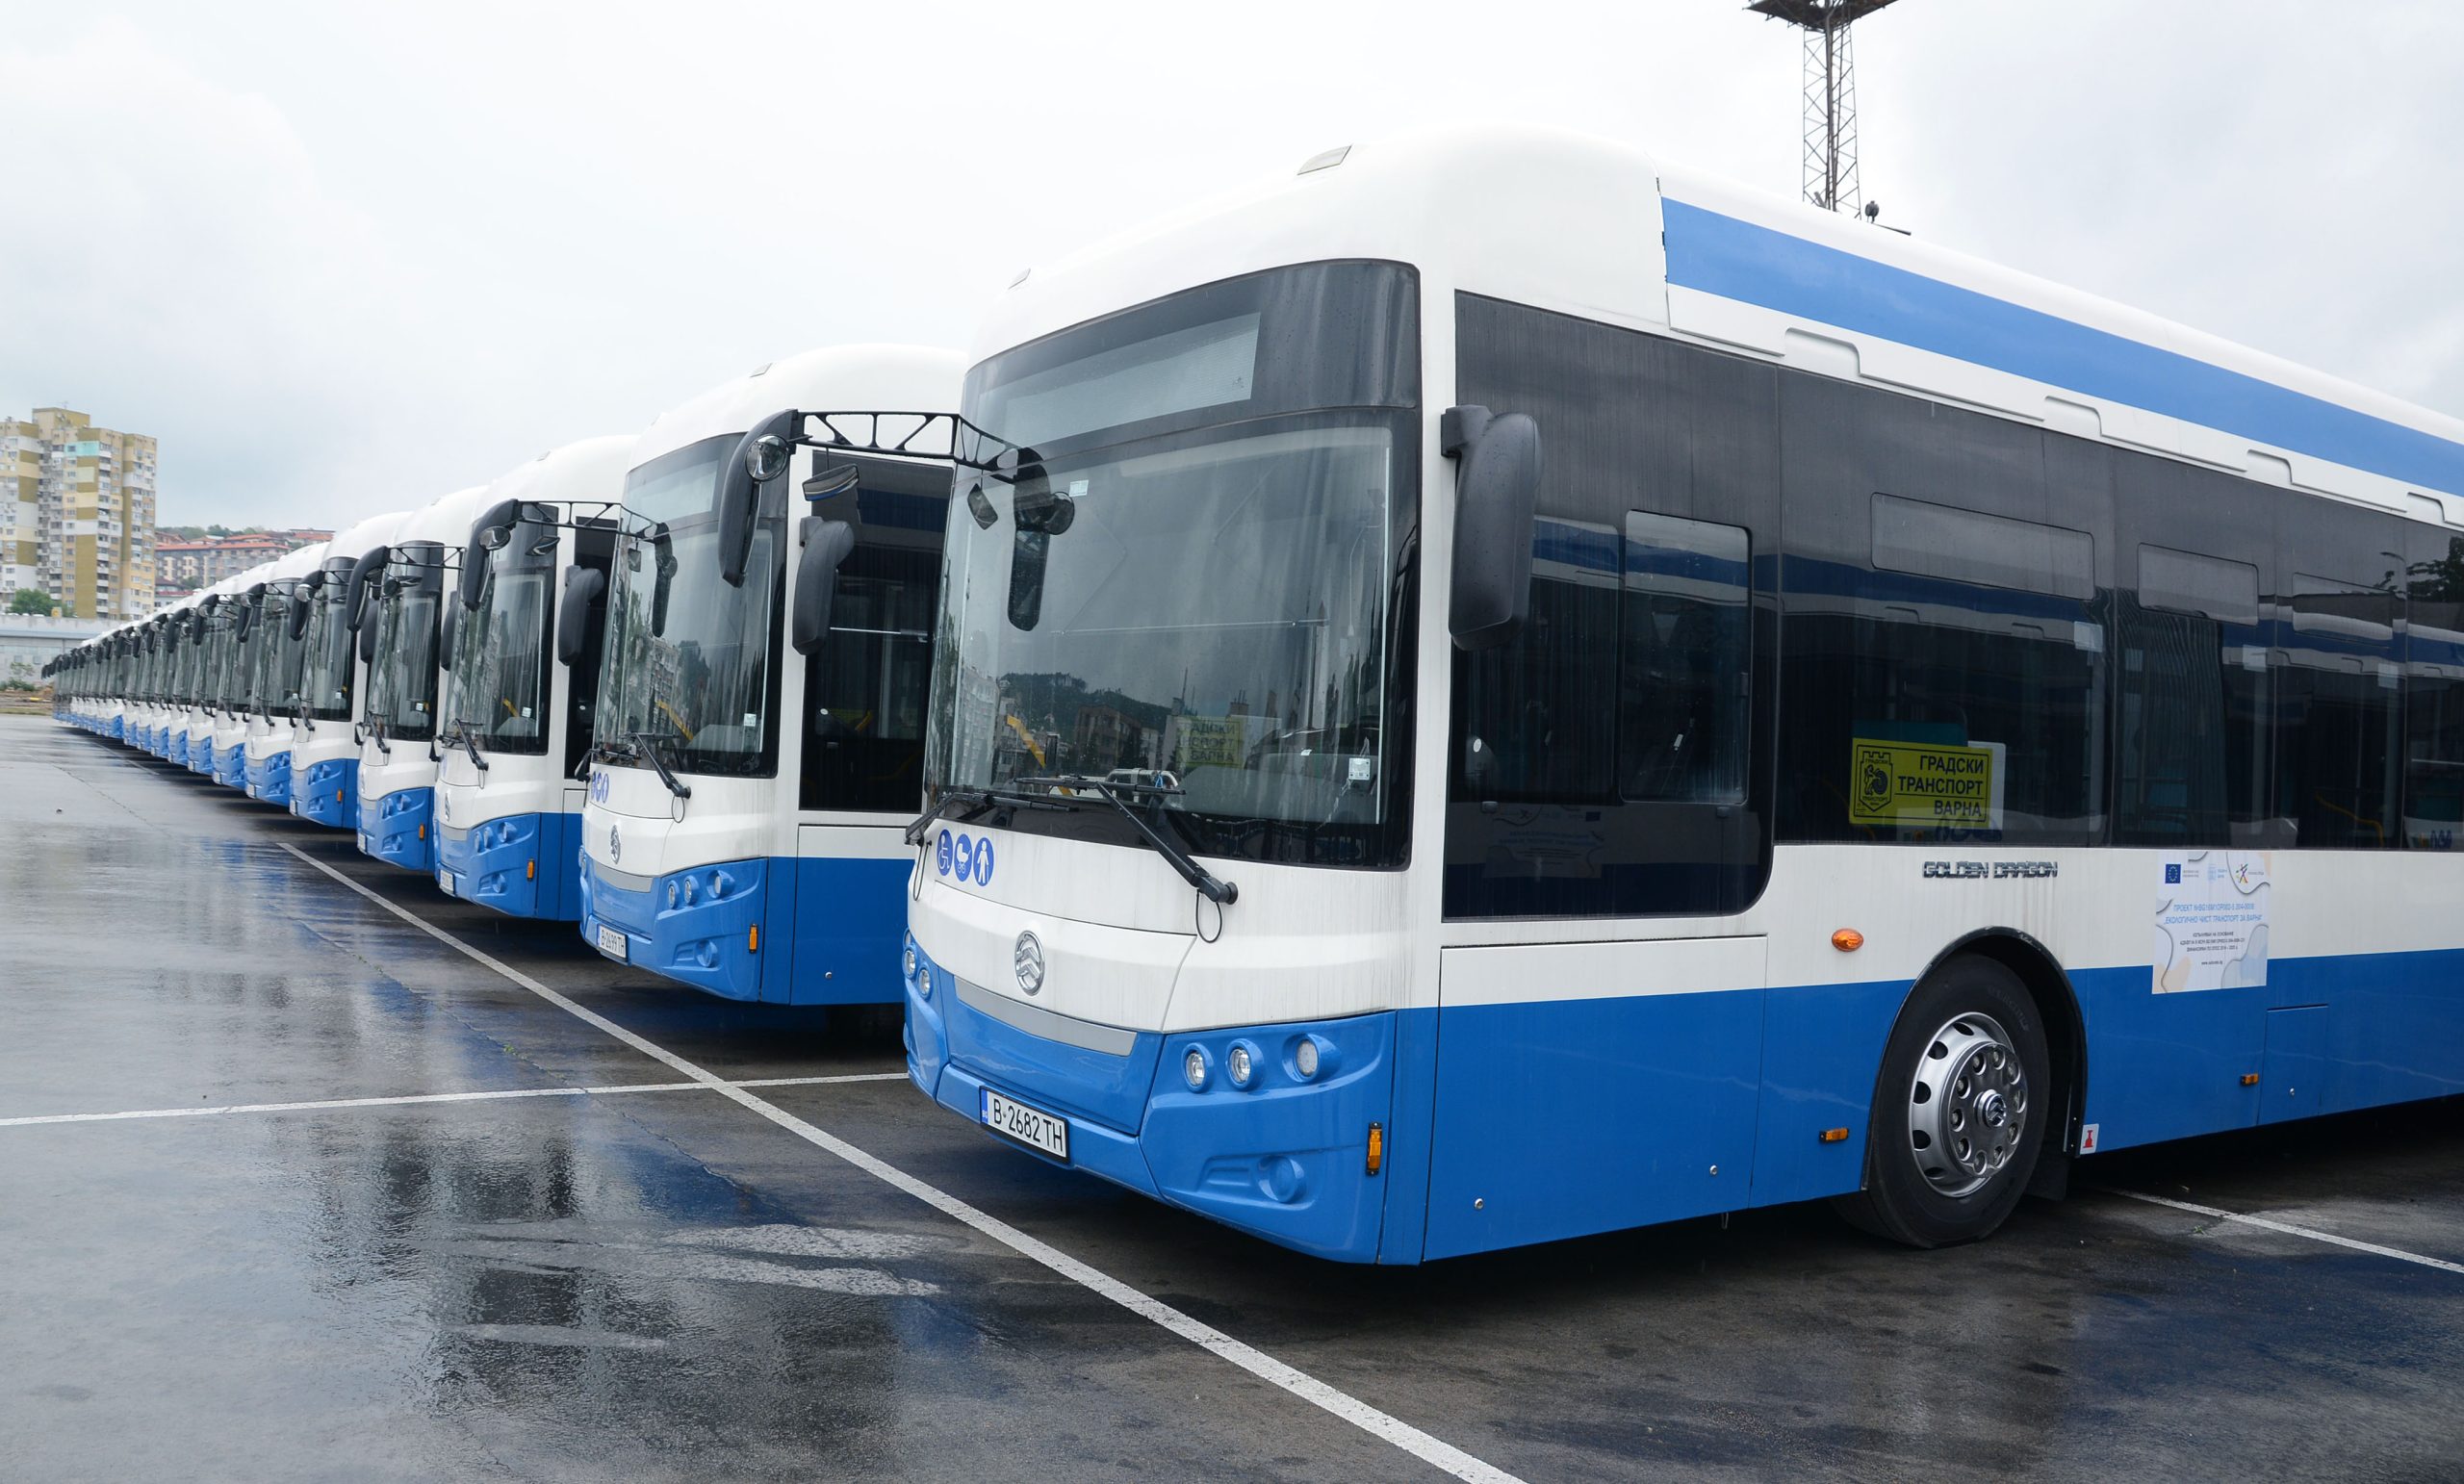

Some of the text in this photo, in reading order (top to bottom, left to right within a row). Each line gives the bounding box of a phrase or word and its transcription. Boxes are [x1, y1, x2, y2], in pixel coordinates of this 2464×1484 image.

[1920, 755, 1984, 775] ГРАДСКИ
[1898, 776, 1983, 795] ТРАНСПОРТ
[1935, 800, 1982, 817] ВАРНА
[1923, 861, 2058, 878] GOLDEN DRAGON
